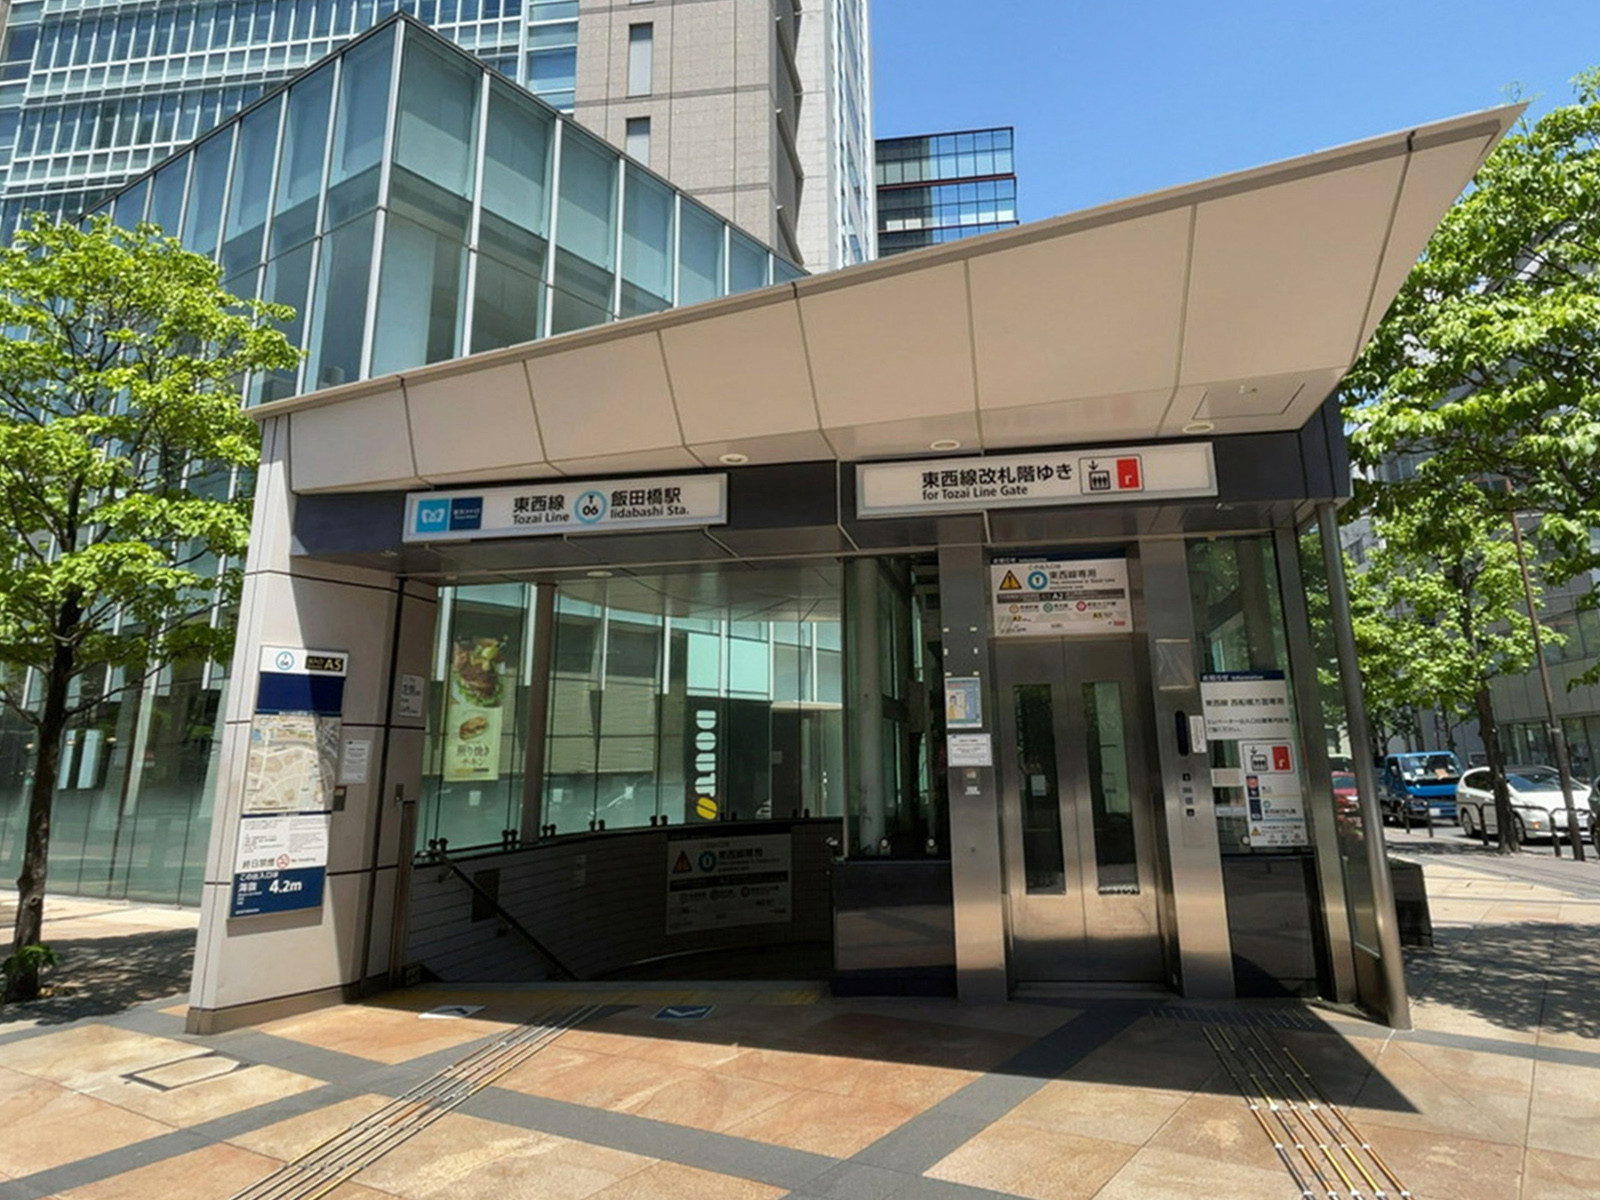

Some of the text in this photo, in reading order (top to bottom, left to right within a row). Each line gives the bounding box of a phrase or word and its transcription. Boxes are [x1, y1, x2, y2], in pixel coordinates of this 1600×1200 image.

[922, 464, 1072, 489] 東西線改札階ゆき
[610, 487, 681, 507] 飯田橋駅
[922, 485, 1028, 500] for Tozai Line Gate
[513, 494, 565, 513] 東西線
[582, 505, 599, 516] 06
[513, 512, 570, 524] Tozai Line
[610, 505, 689, 519] Iidabashi Sta.
[269, 879, 302, 893] 4.2m
